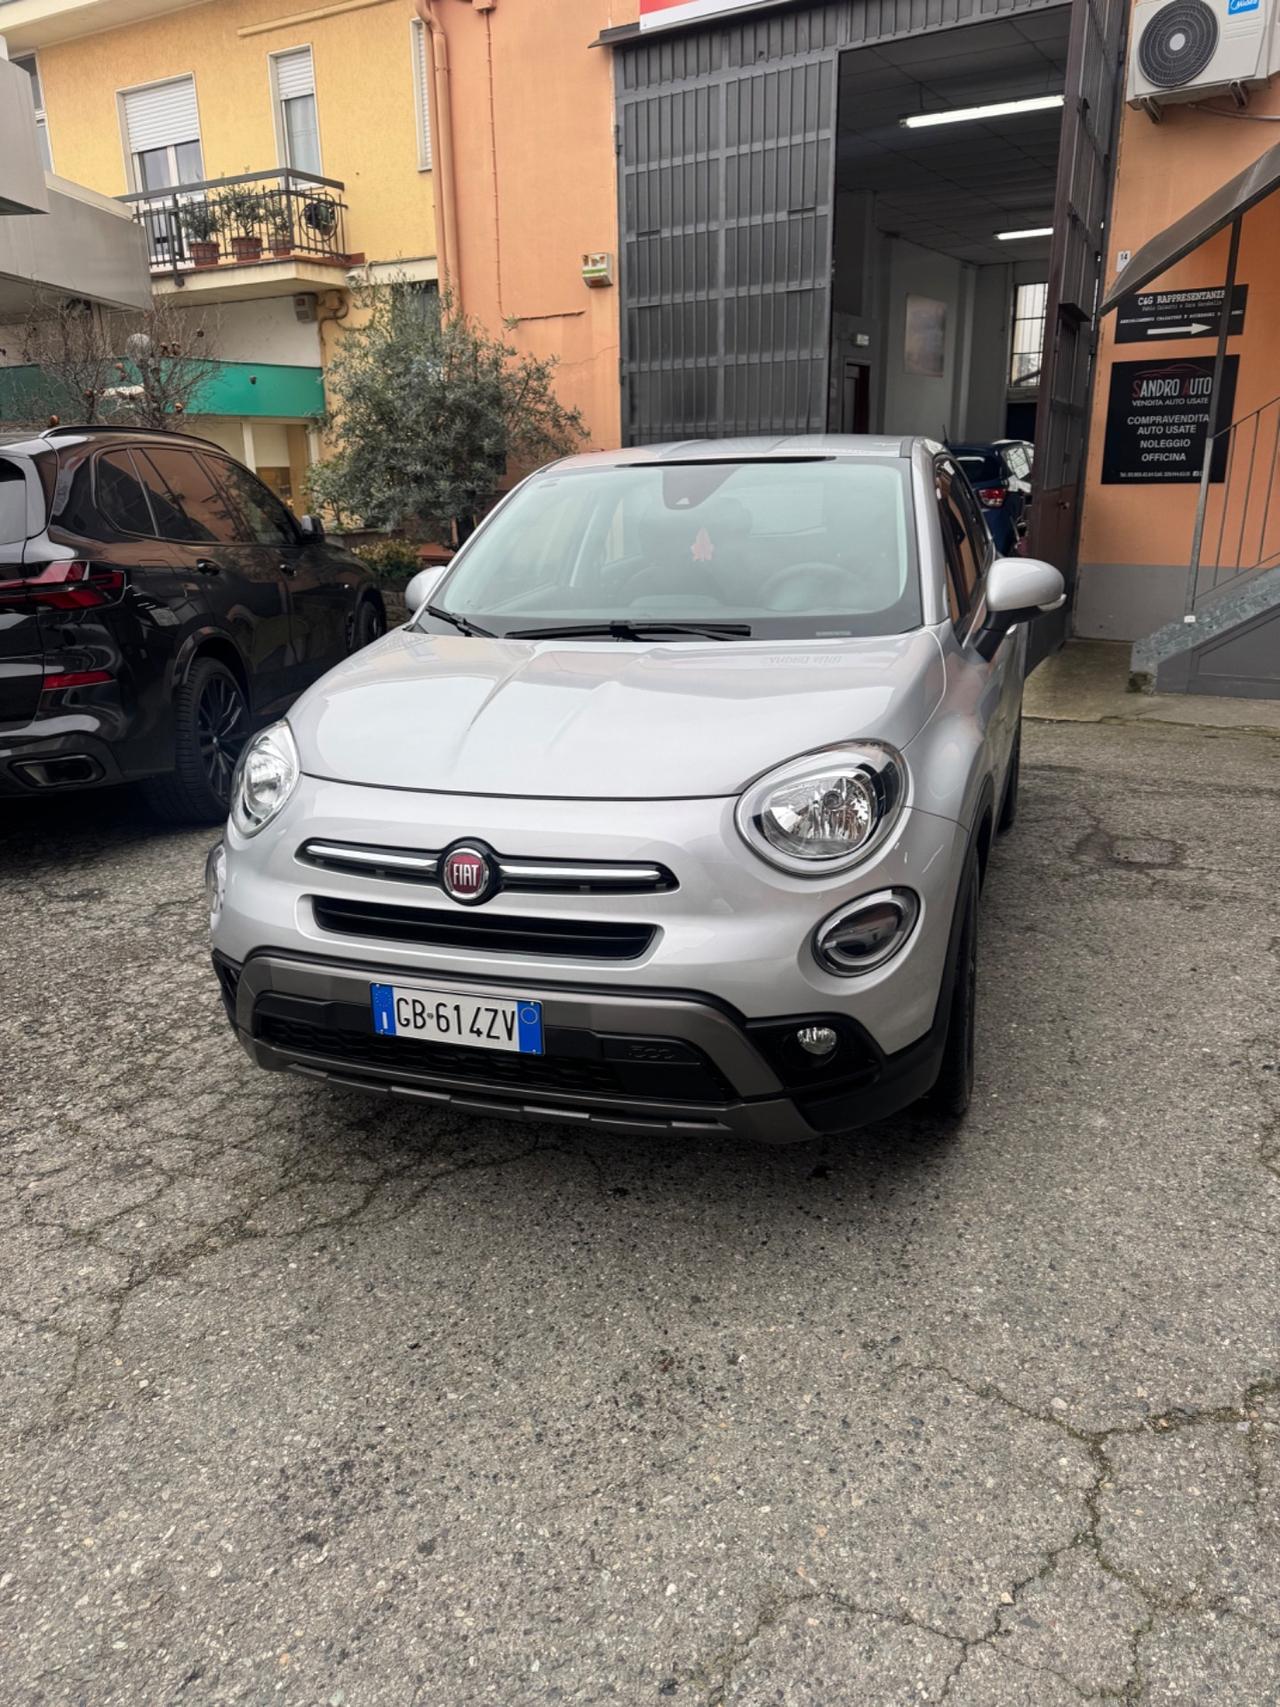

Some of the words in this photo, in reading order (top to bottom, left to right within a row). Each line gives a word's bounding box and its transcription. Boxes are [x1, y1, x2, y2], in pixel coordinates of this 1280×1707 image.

[1132, 379, 1180, 398] SANDRO
[1183, 377, 1212, 396] AUTO
[1132, 399, 1163, 407] VENDITA
[1165, 398, 1185, 406] AUTO
[1127, 414, 1210, 425] COMPRAVENDITA
[1137, 426, 1164, 435] AUTO
[1165, 424, 1197, 434] USATE
[1140, 439, 1191, 448] NOLEGGIO
[1141, 453, 1187, 462] OFFICINA
[453, 863, 479, 886] FIAT
